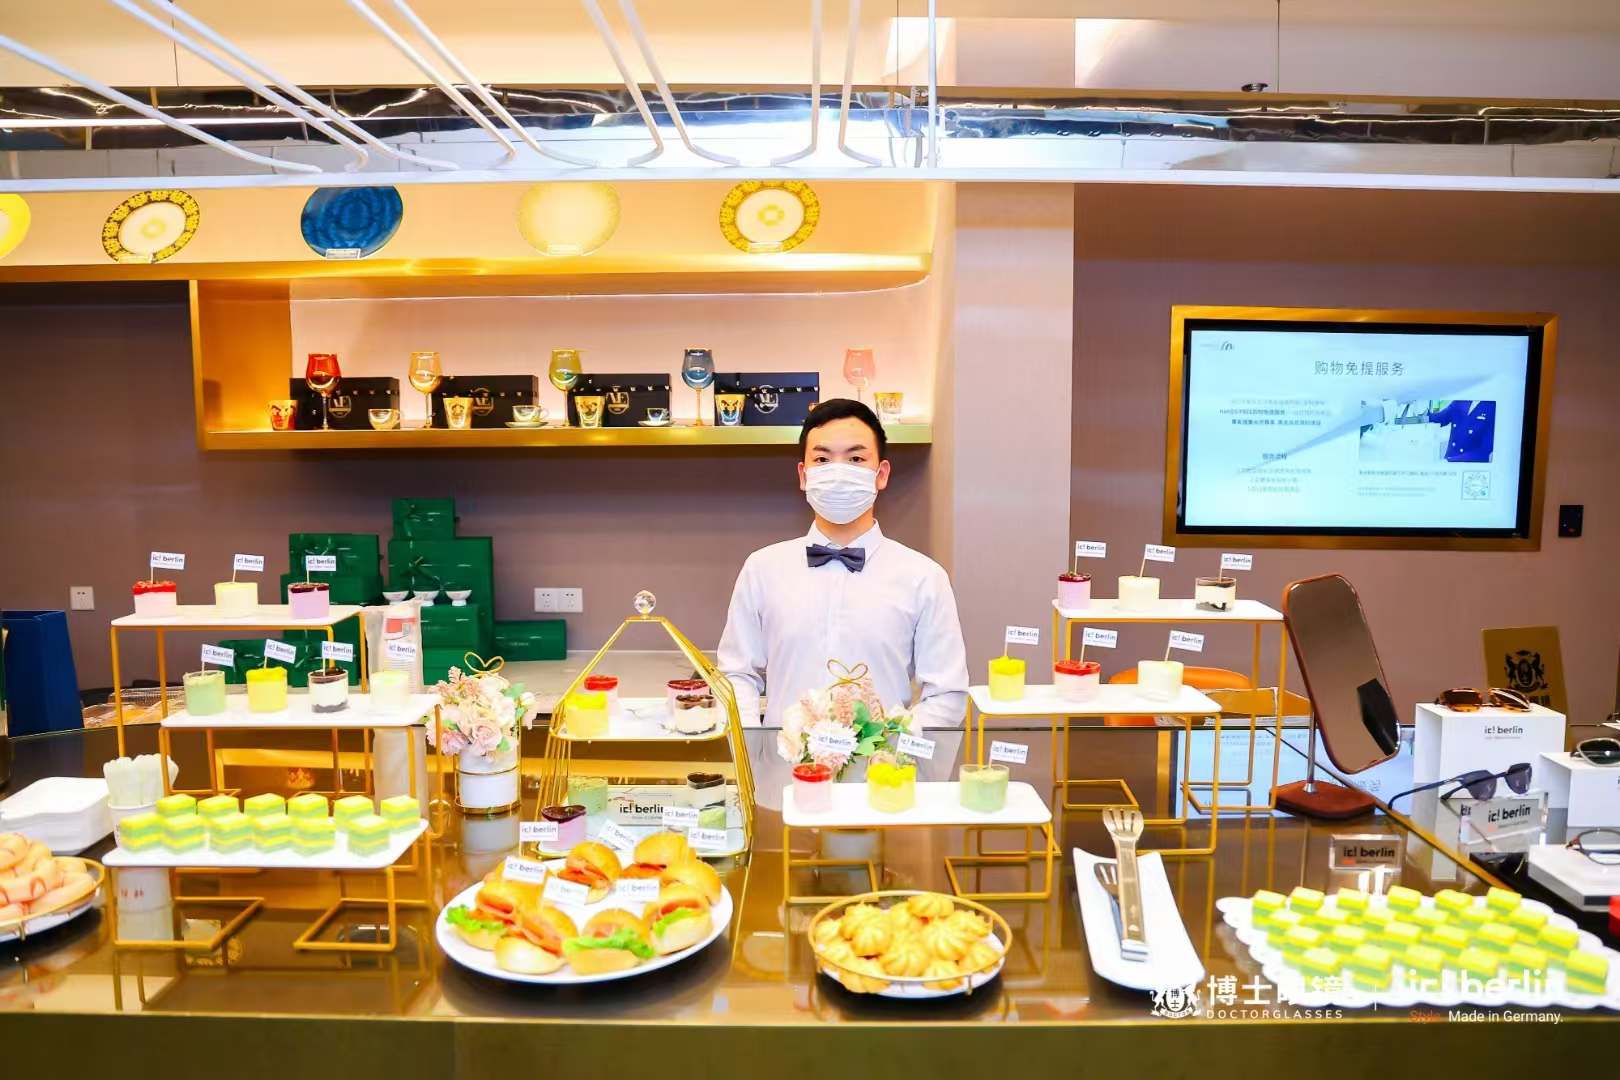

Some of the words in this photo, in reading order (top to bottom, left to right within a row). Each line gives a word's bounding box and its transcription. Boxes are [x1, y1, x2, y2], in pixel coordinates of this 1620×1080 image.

[1314, 360, 1404, 376] 购物免提服务
[1095, 631, 1116, 640] berlin
[1181, 635, 1202, 644] berlin
[212, 650, 232, 659] berlin
[276, 646, 294, 655] berlin
[1484, 726, 1495, 734] ic!
[1498, 725, 1523, 734] berlin
[829, 737, 851, 746] berlin
[911, 740, 933, 750] berlin
[1004, 746, 1026, 754] berlin
[620, 803, 632, 813] ic!
[1488, 809, 1500, 822] ic!
[1502, 804, 1531, 820] berlin
[533, 824, 557, 833] berlin
[701, 832, 725, 840] berlin
[1361, 846, 1394, 857] berlin
[519, 865, 543, 873] berlin
